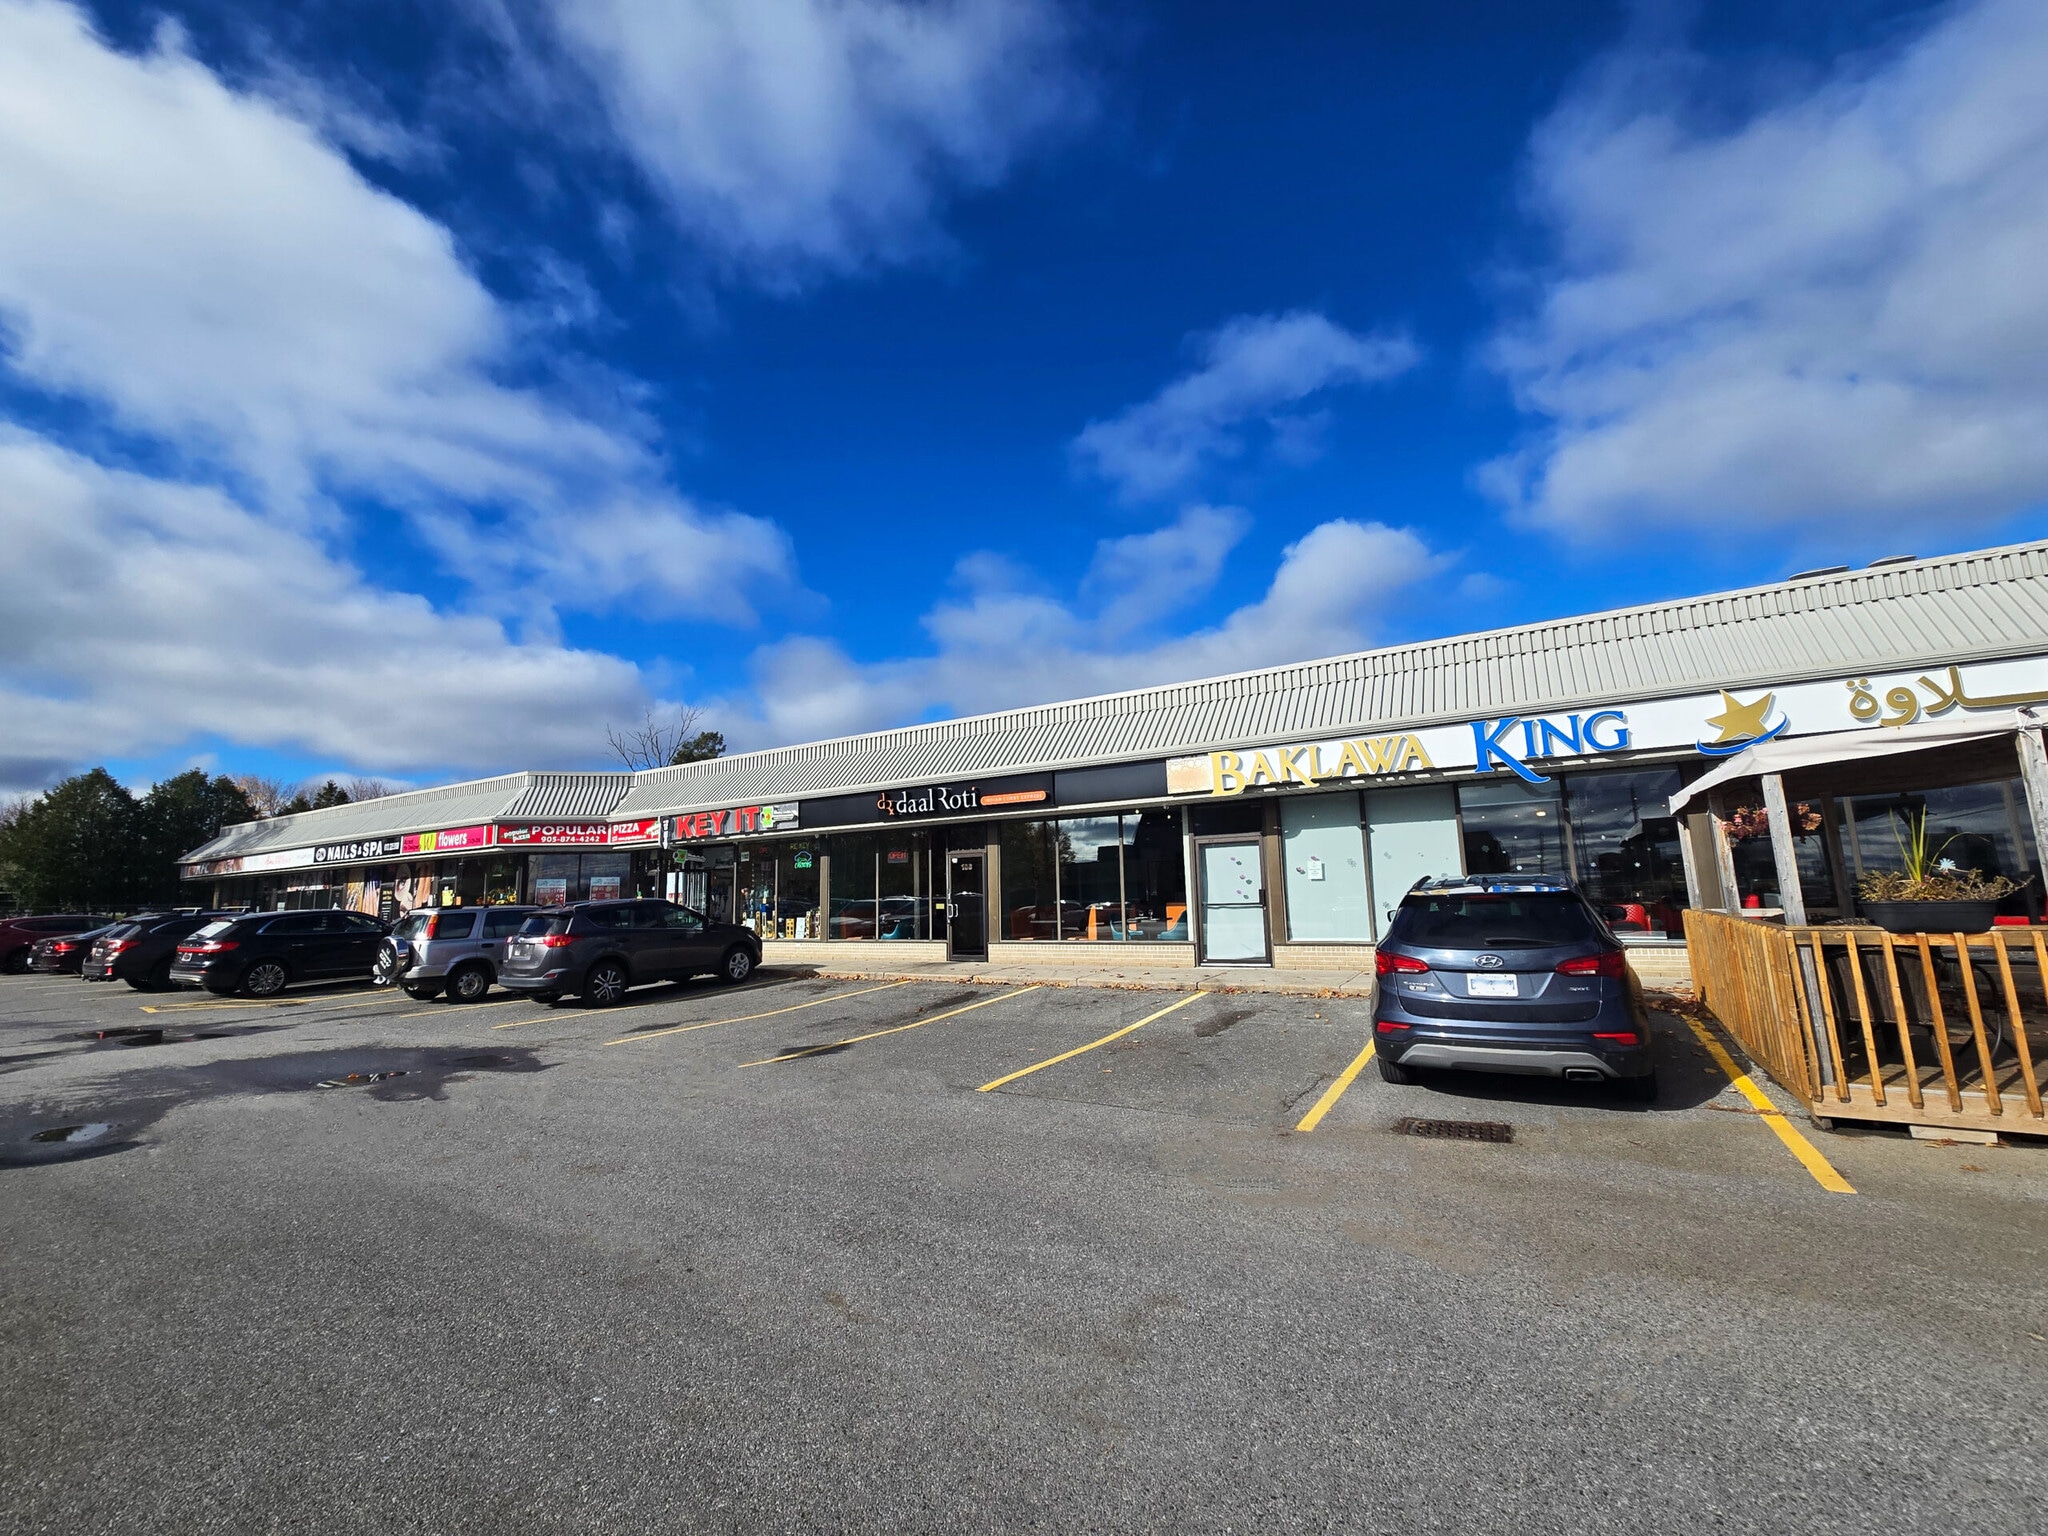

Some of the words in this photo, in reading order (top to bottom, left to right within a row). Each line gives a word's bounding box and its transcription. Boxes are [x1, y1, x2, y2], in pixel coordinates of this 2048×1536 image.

[896, 788, 935, 814] daal
[937, 786, 978, 810] Roti
[612, 822, 640, 835] PIZZA
[676, 809, 727, 840] KEY
[734, 805, 761, 833] IT
[531, 825, 607, 836] POPULAR
[437, 831, 468, 848] flowers
[540, 835, 600, 843] 905-874-4242
[327, 843, 358, 861] NAILS
[362, 840, 383, 858] SPA
[888, 851, 907, 860] OPEN
